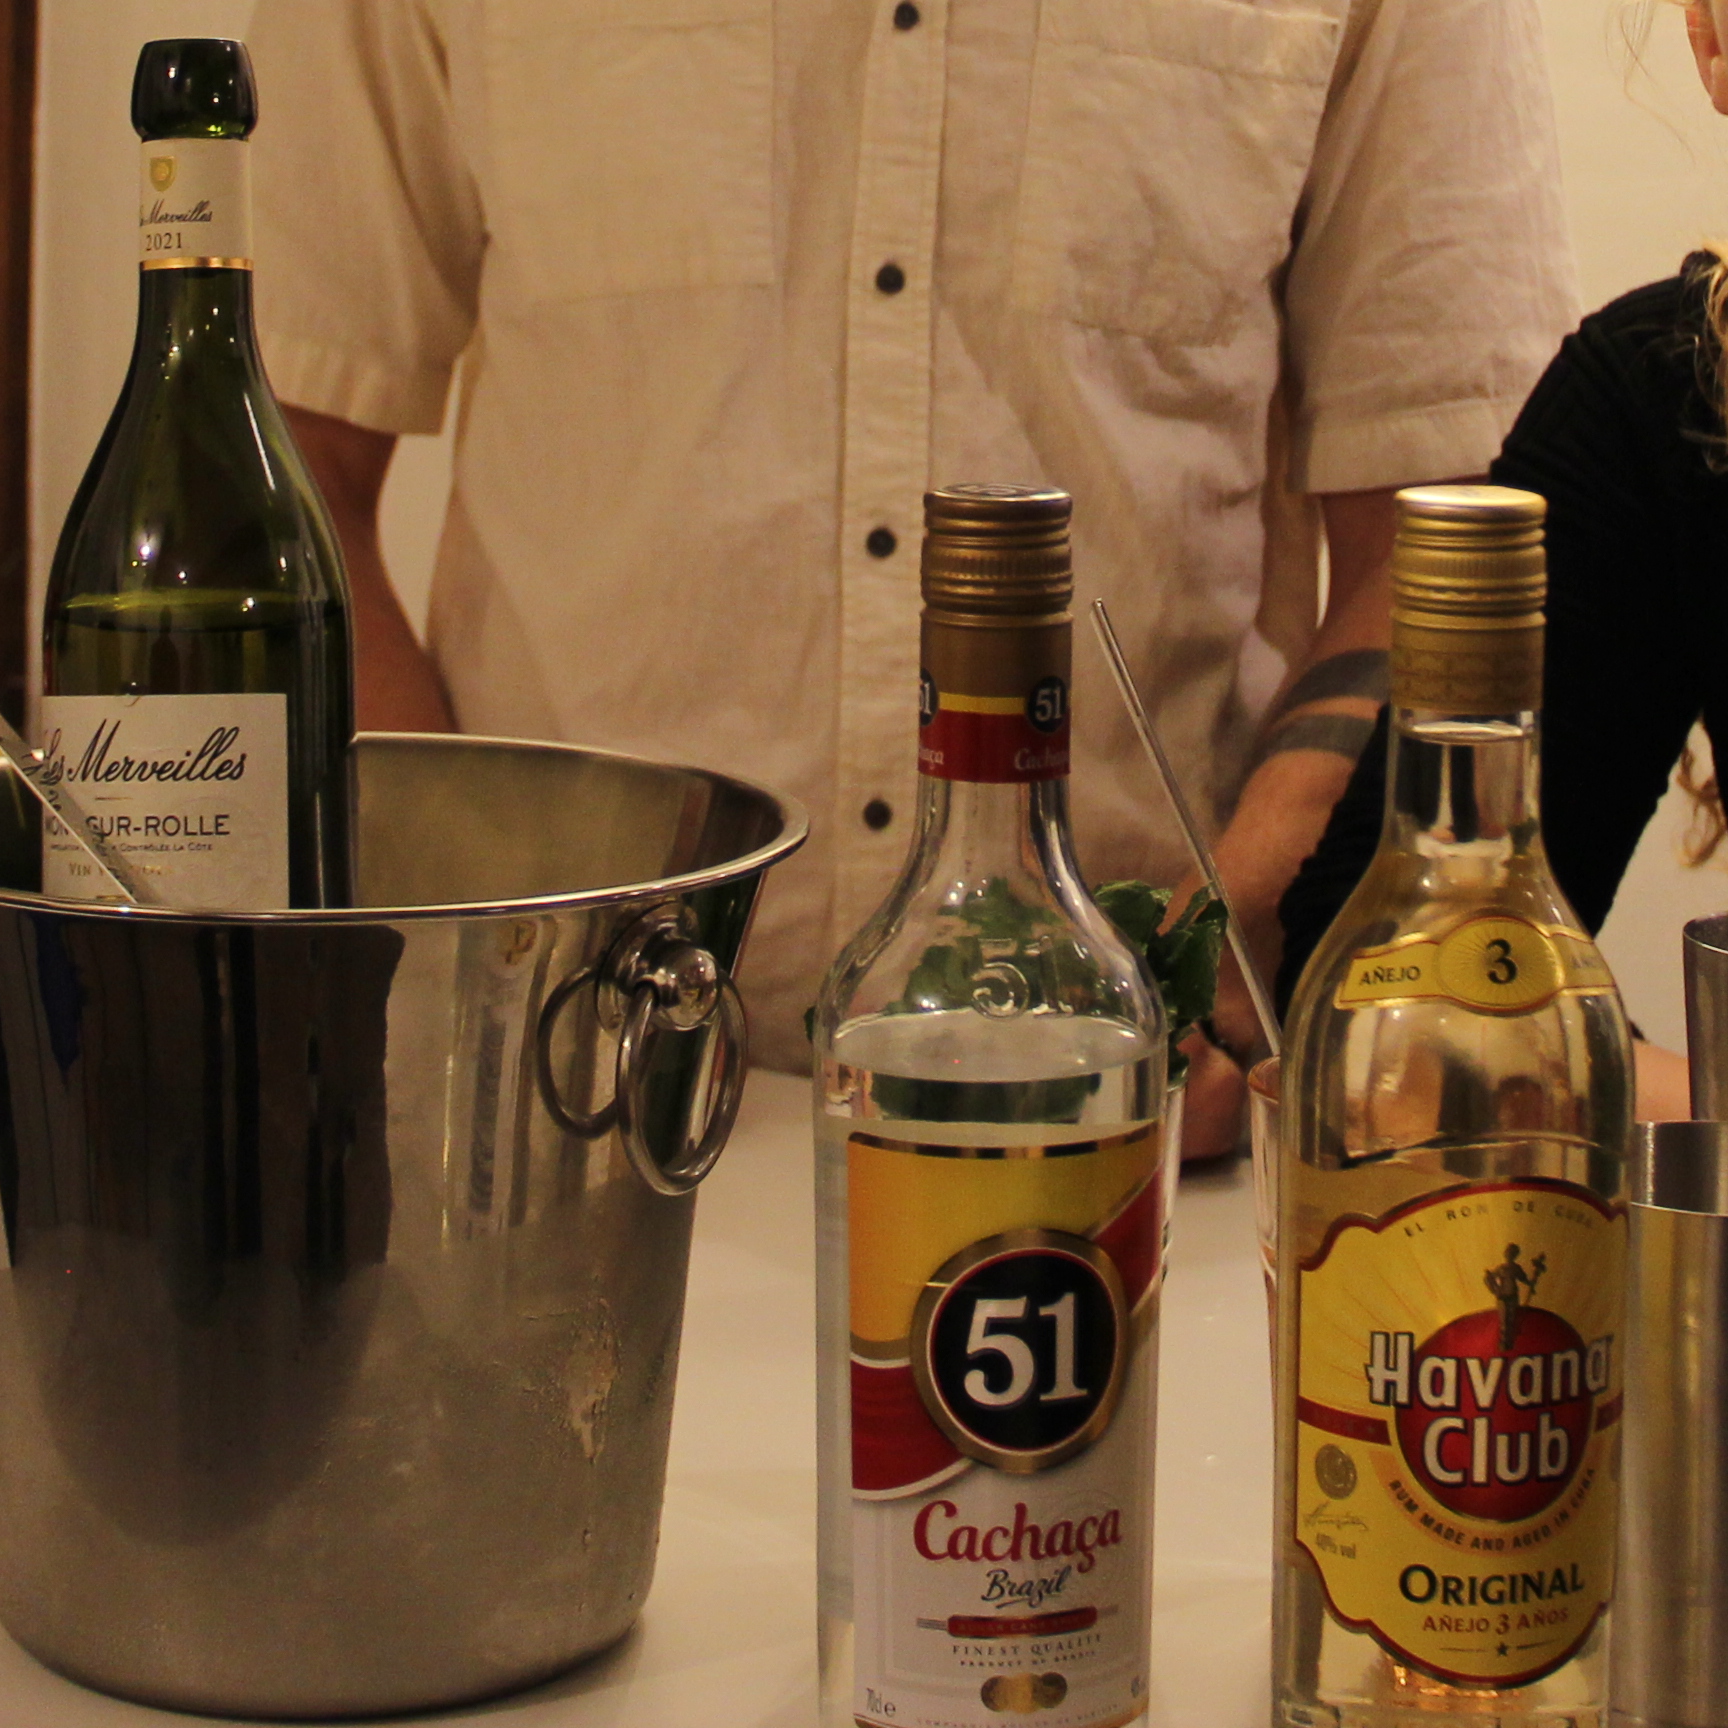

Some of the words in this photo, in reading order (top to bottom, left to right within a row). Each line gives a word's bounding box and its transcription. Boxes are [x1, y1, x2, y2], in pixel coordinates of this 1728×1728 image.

[145, 232, 182, 252] 2021
[1034, 686, 1063, 723] 51
[67, 718, 247, 784] Merveilles
[1358, 964, 1422, 987] AÑEJO
[1485, 938, 1519, 985] 3
[963, 1291, 1090, 1408] 51
[1364, 1330, 1615, 1408] Havana
[1421, 1413, 1572, 1486] Club
[912, 1499, 1123, 1574] Cachaça
[1388, 1479, 1419, 1514] RUM
[1420, 1512, 1466, 1545] MADE
[1470, 1536, 1505, 1552] AND
[1512, 1525, 1552, 1549] AGED
[1554, 1509, 1570, 1527] IN
[980, 1564, 1073, 1609] Brazil
[1398, 1563, 1585, 1607] ORIGINAL
[1422, 1613, 1490, 1633] AÑEJO
[1495, 1613, 1511, 1635] 3
[1516, 1606, 1570, 1630] AÑOS
[952, 1644, 1021, 1657] FINEST
